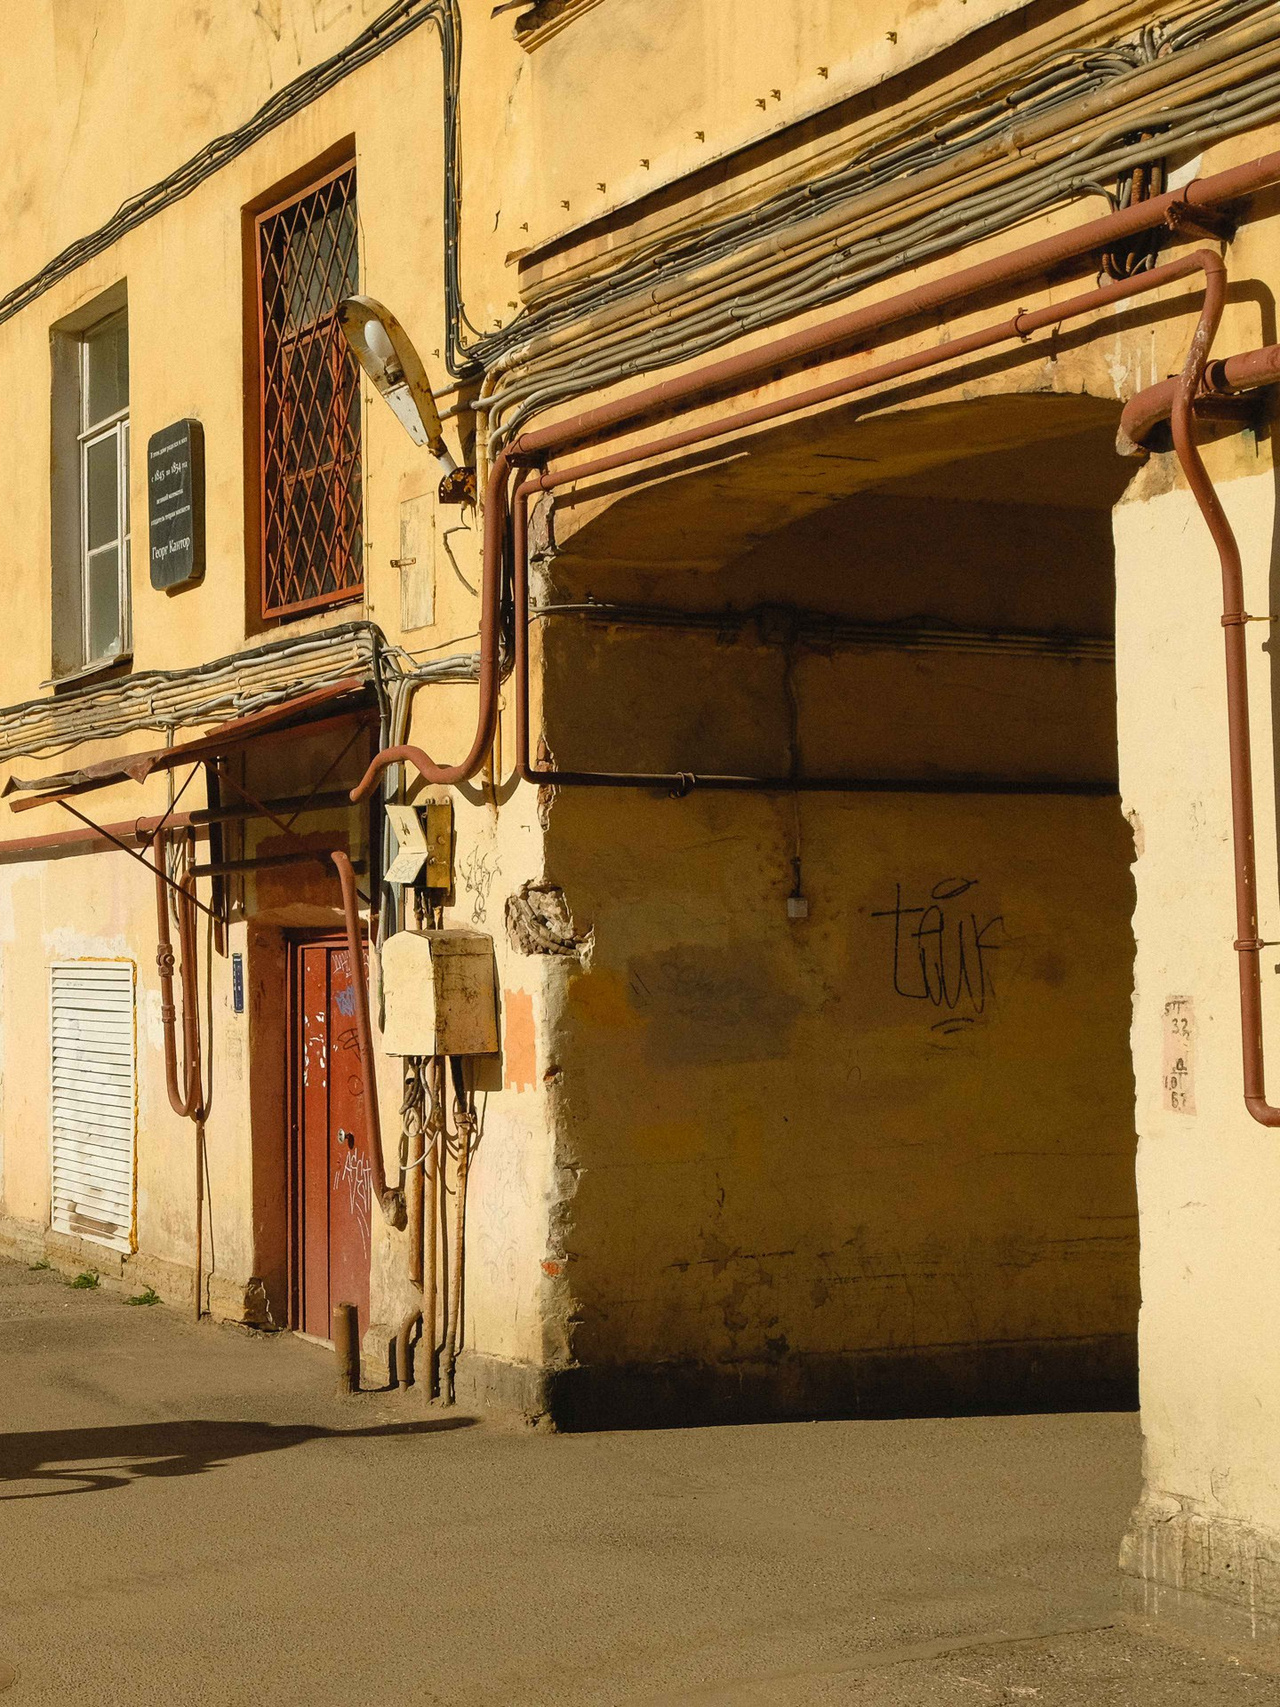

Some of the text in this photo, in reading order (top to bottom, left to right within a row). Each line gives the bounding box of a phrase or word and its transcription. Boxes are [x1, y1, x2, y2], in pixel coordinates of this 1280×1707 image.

[154, 469, 166, 482] 1845
[171, 461, 182, 475] 1854
[152, 536, 191, 561] Георг Кантор
